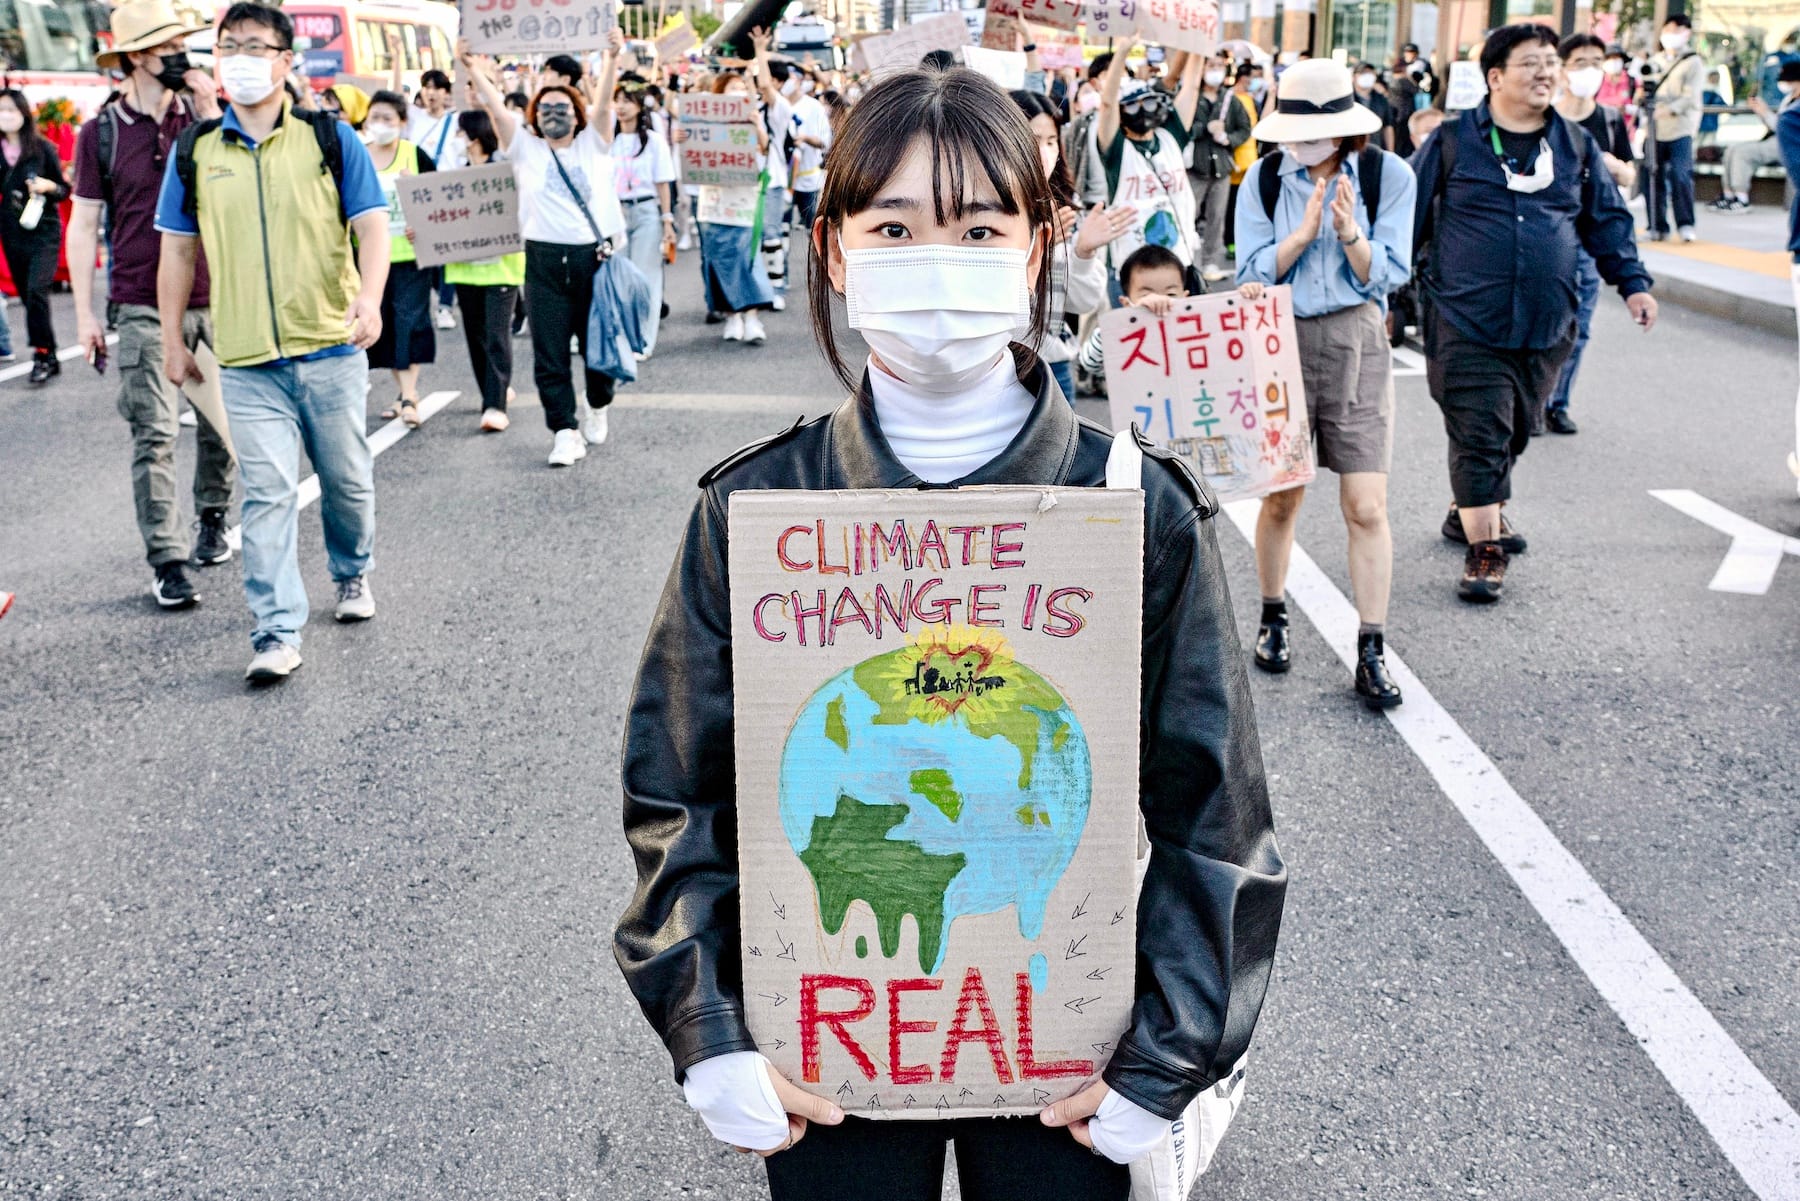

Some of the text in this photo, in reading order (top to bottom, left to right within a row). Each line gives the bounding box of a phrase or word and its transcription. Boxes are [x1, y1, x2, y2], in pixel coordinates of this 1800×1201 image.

[297, 15, 334, 36] 1900
[479, 14, 513, 39] the
[518, 3, 615, 42] earth
[1119, 297, 1283, 377] 지금당장
[1133, 380, 1290, 439] 기후정의
[777, 518, 1027, 577] CLIMATE
[752, 579, 1094, 647] CHANGE IS
[797, 966, 1095, 1085] REAL
